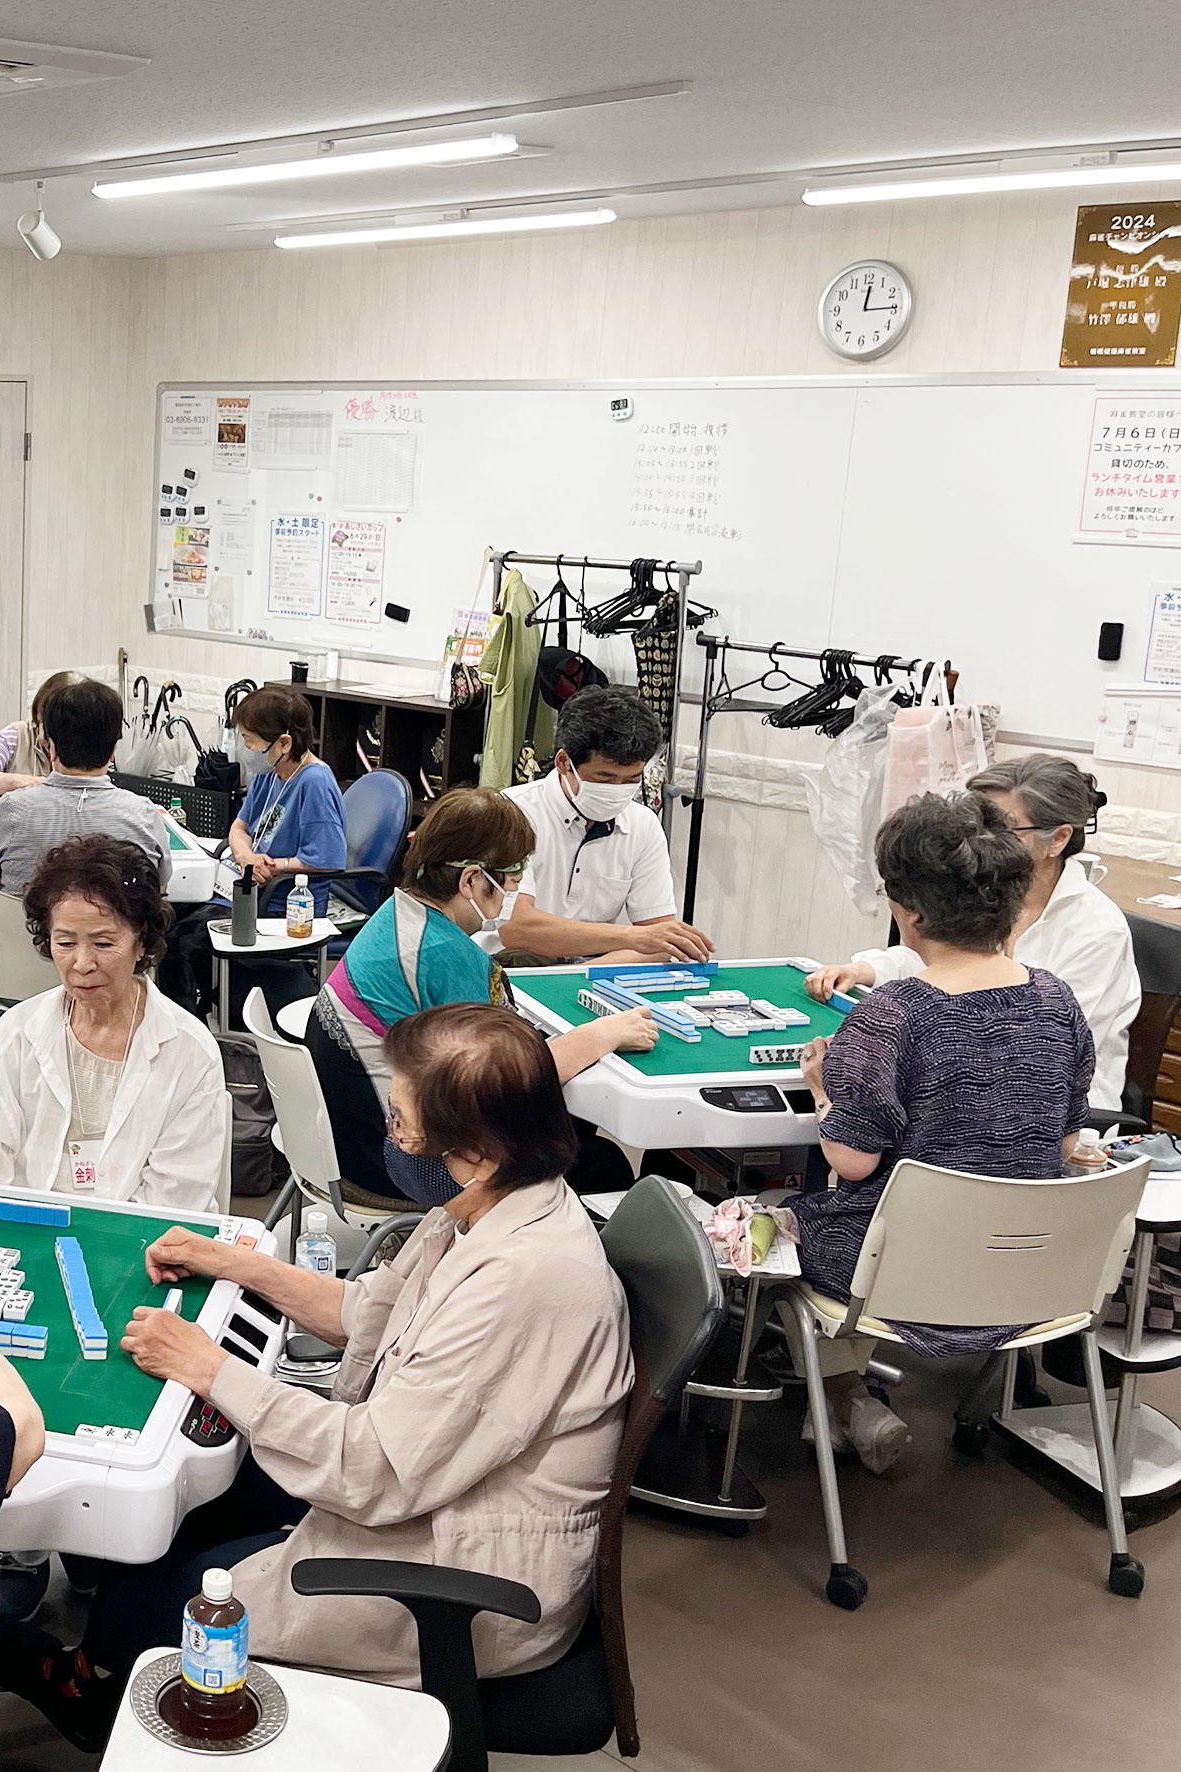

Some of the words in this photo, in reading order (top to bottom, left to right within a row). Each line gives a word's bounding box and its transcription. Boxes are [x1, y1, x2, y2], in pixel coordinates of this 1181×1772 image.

[1110, 213, 1156, 230] 2024
[850, 278, 859, 290] 11
[863, 273, 875, 285] 12
[881, 277, 885, 289] 1
[838, 289, 849, 302] 10
[888, 287, 896, 299] 2
[833, 305, 841, 317] 9
[835, 320, 843, 332] 8
[884, 319, 891, 331] 4
[845, 331, 851, 343] 7
[857, 335, 865, 347] 6
[872, 330, 880, 342] 5
[75, 1167, 96, 1184] 金刺
